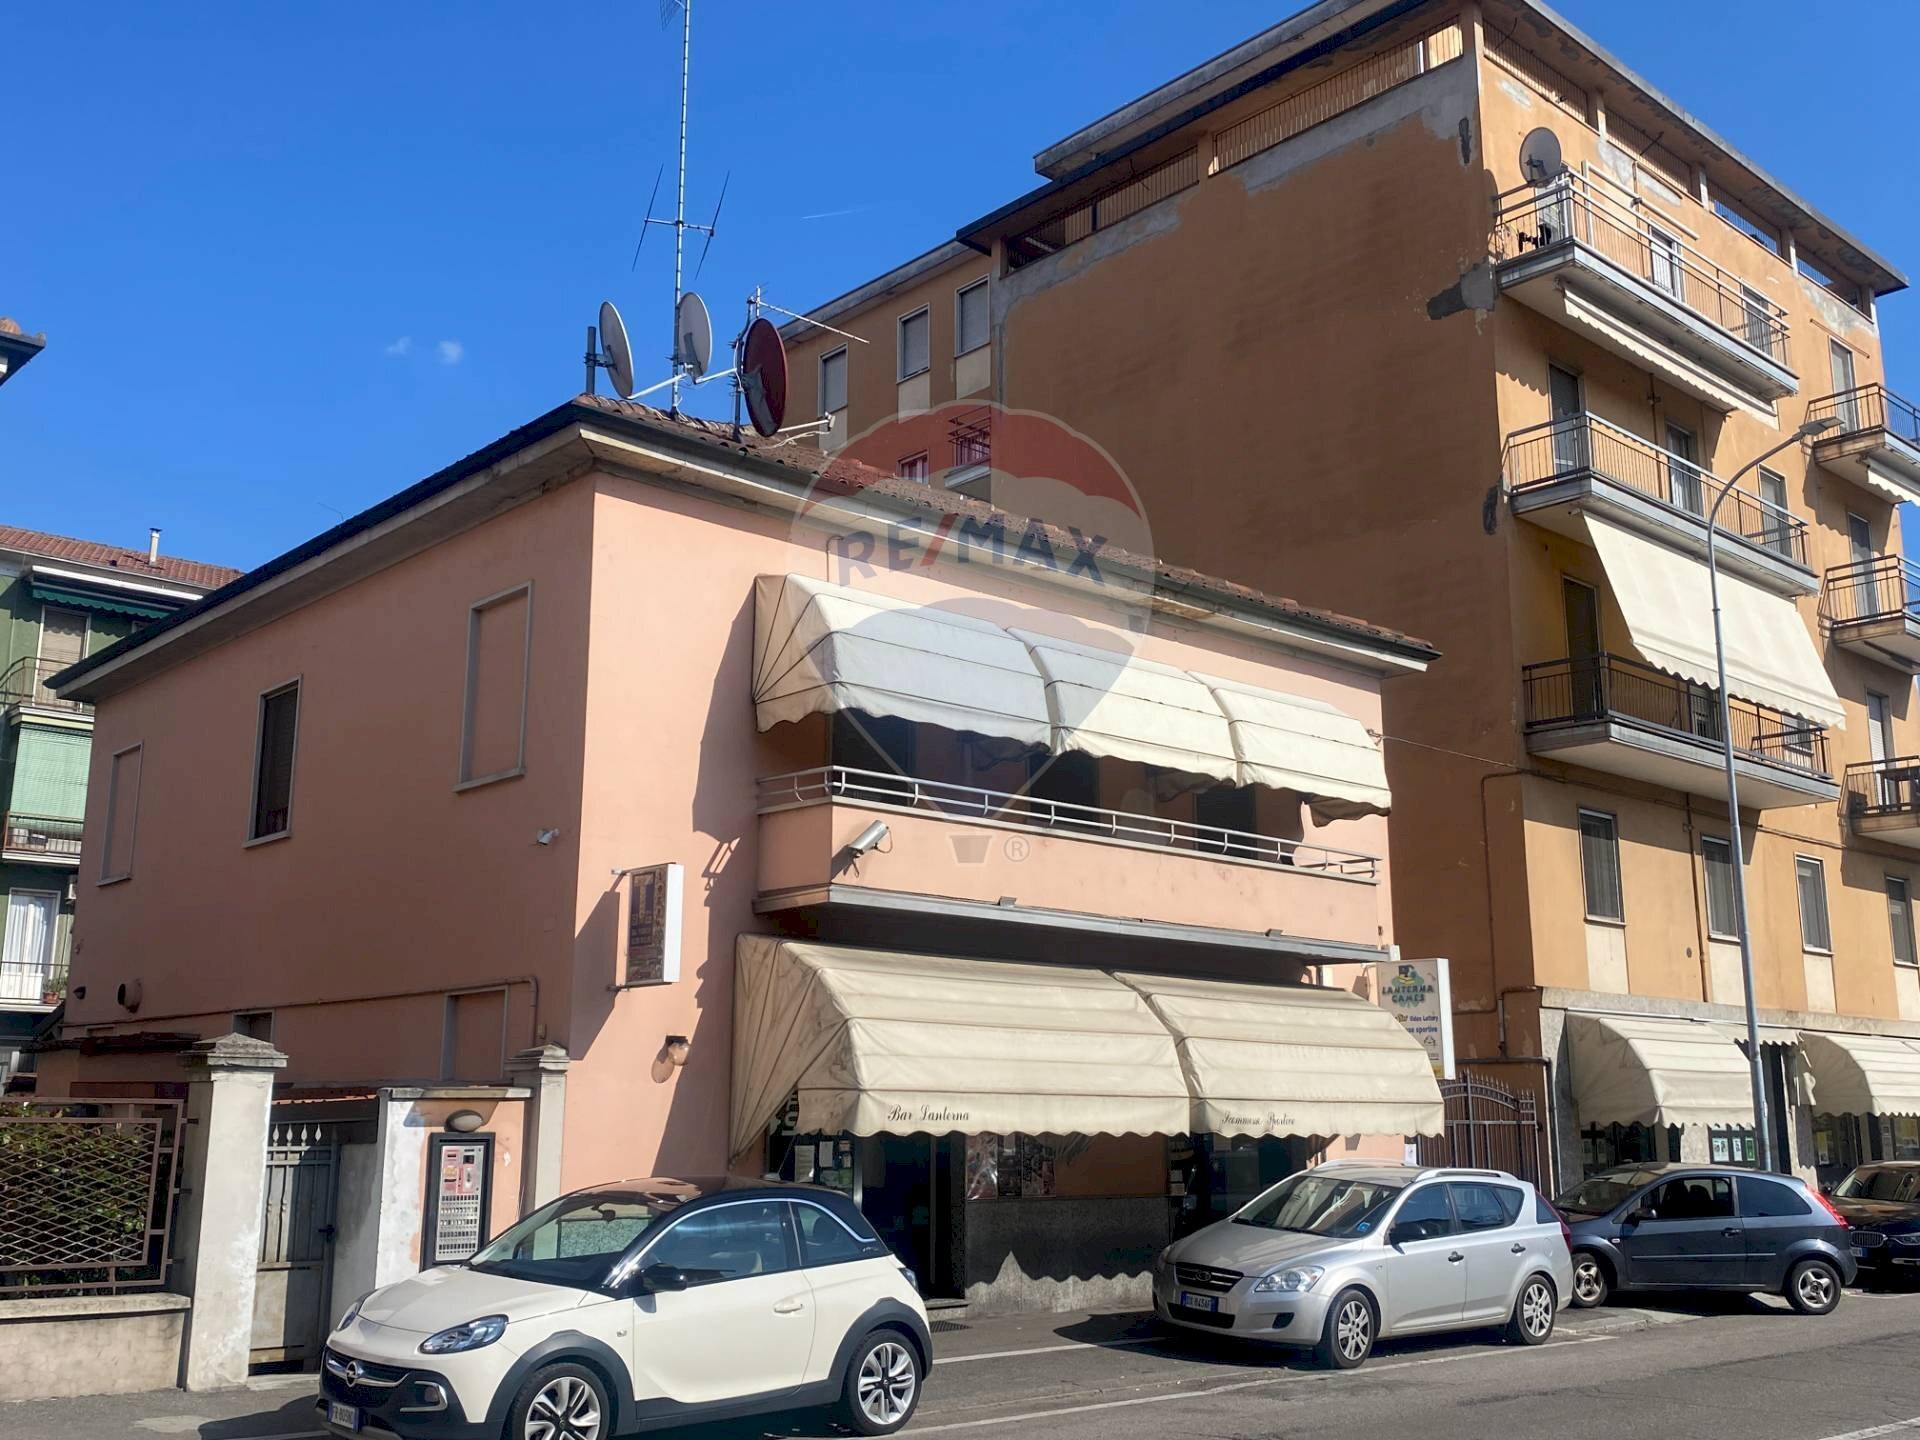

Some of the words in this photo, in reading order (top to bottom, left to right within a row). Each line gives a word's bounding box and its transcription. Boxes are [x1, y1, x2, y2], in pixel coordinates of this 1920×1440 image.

[1382, 985, 1434, 994] LANTERNA
[1391, 994, 1425, 1003] GAMES
[888, 1104, 912, 1121] Bar
[919, 1104, 969, 1121] Lanterna
